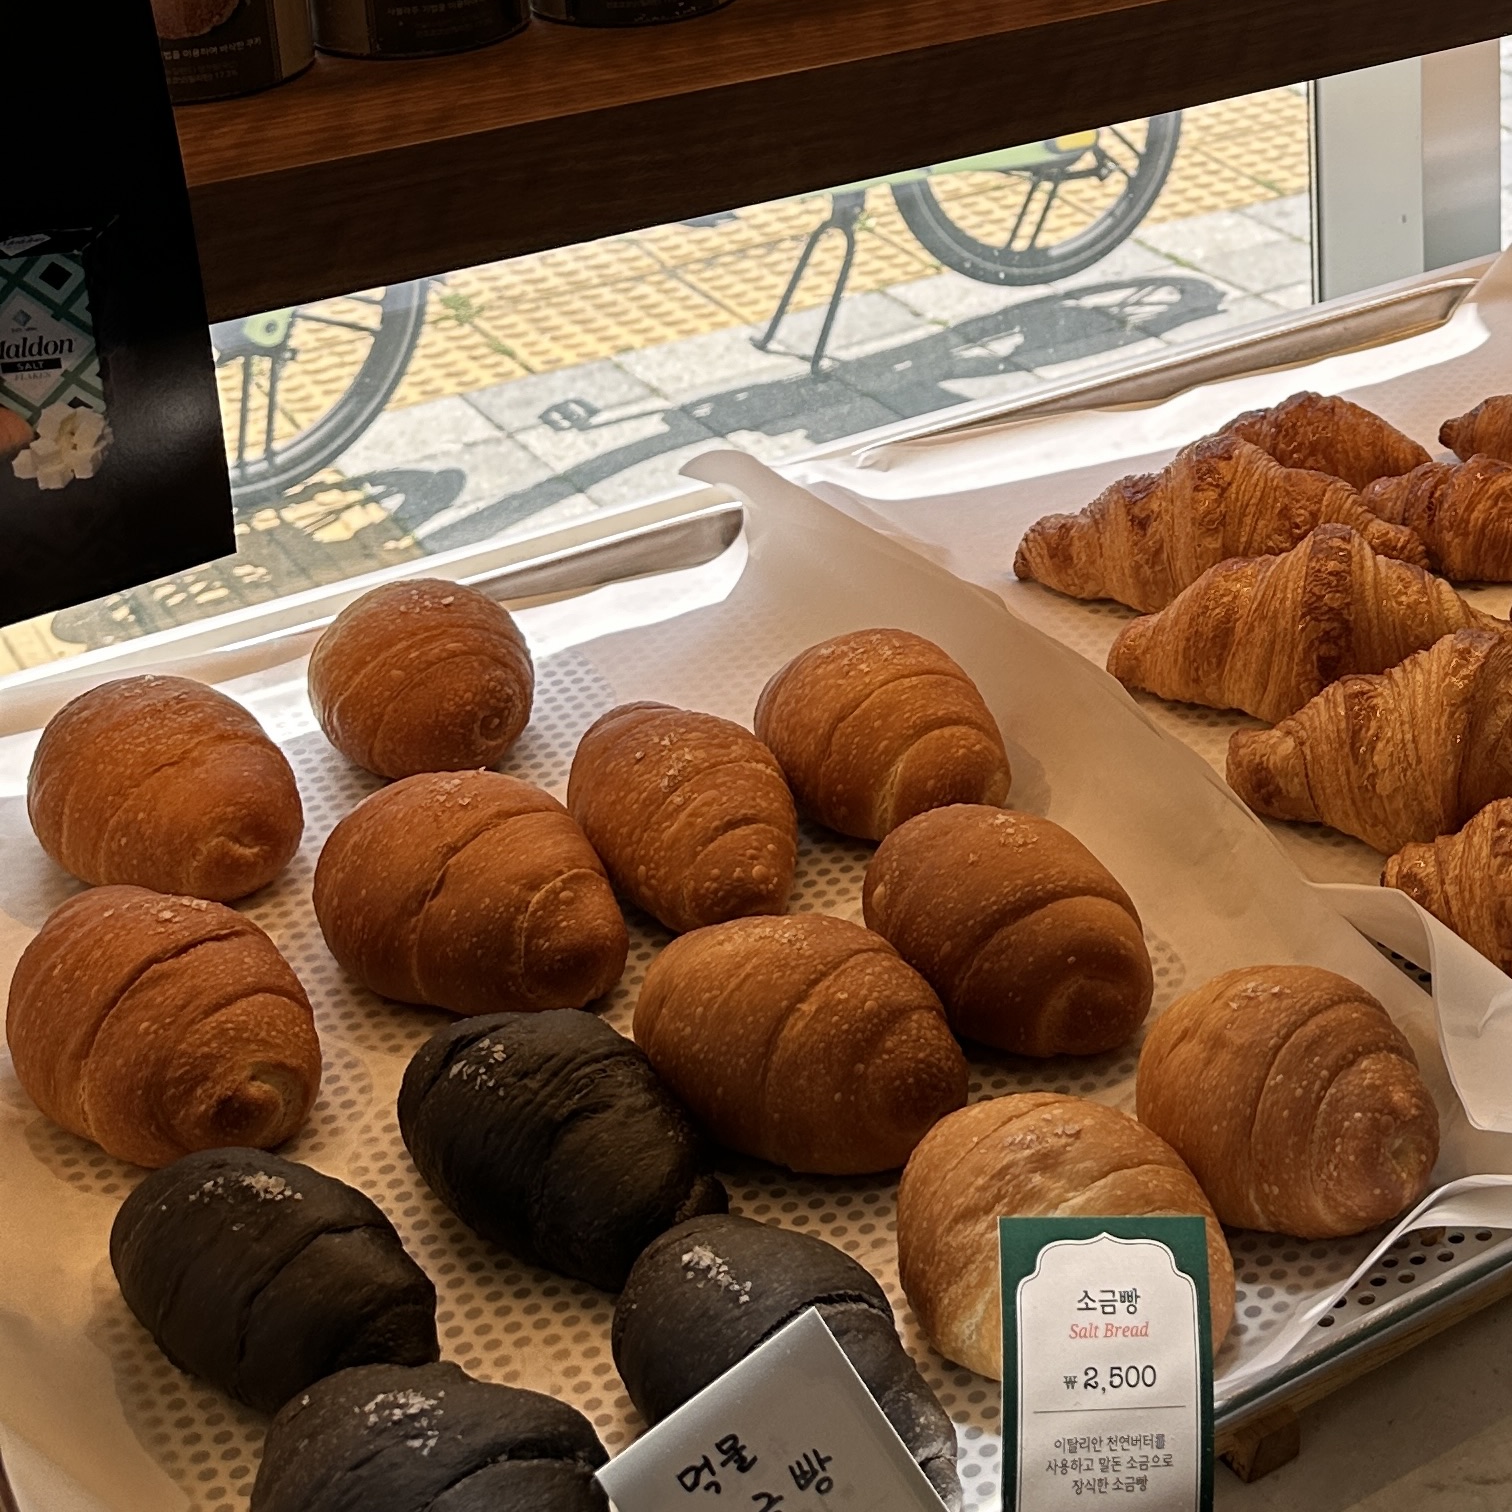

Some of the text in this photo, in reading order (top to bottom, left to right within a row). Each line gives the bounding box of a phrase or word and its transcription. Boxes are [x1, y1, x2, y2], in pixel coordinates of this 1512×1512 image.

[0, 335, 74, 360] aldon
[16, 359, 46, 371] SALT
[1076, 1287, 1141, 1315] 소금빵
[1068, 1321, 1150, 1340] Salt Bread
[1083, 1364, 1157, 1395] 2,500
[1054, 1433, 1166, 1454] 이탈리안 천연버터를
[676, 1432, 758, 1495] 먹물
[1045, 1453, 1174, 1476] 사용하고 말돈 소금으로
[1071, 1474, 1149, 1496] 장식한 소금빵
